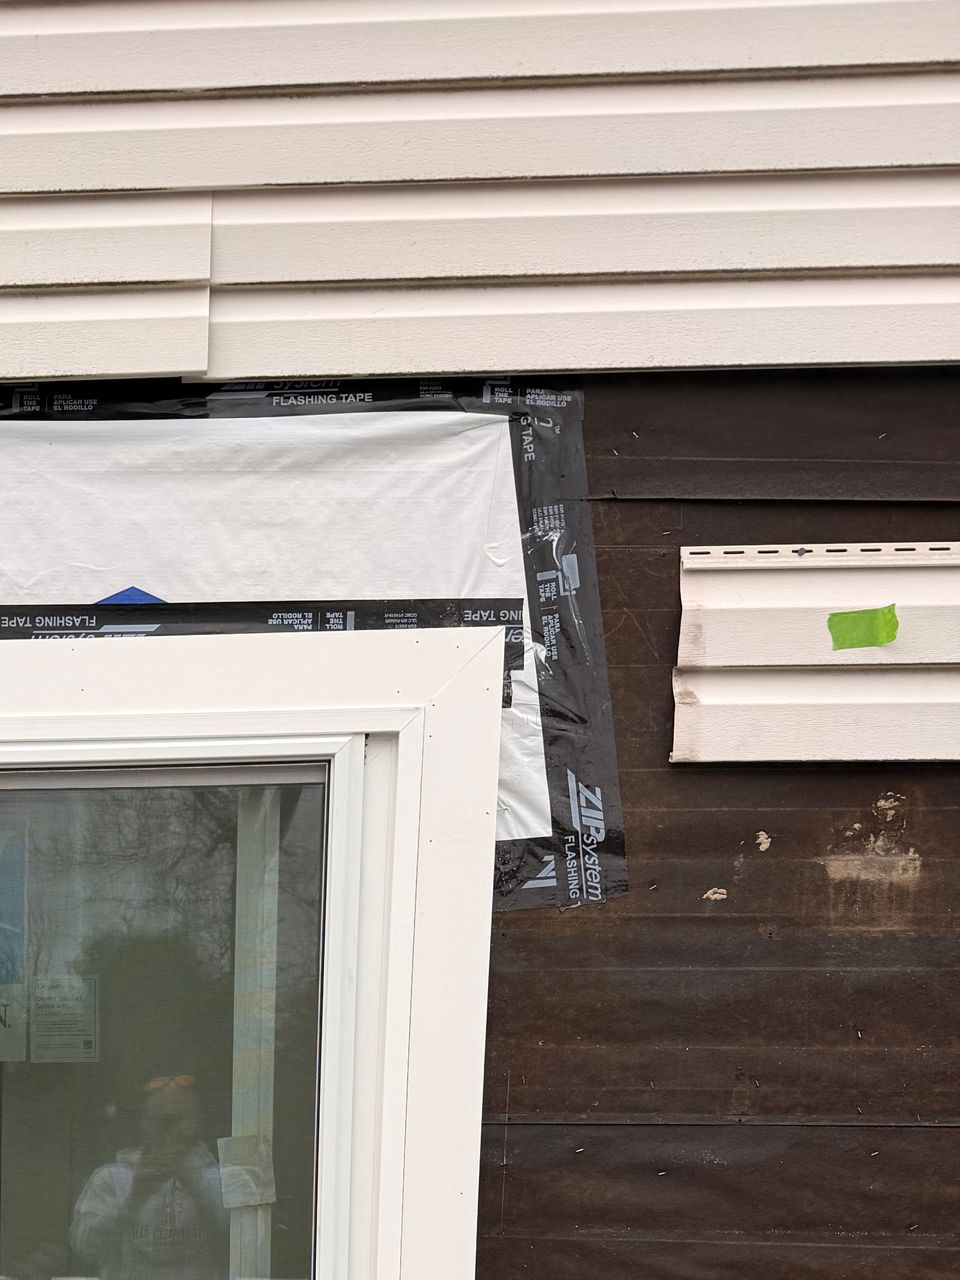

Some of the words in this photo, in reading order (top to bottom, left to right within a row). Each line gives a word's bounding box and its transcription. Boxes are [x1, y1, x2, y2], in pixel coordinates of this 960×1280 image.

[272, 395, 337, 406] FLASHING
[340, 393, 373, 402] TAPE
[522, 427, 535, 462] TAPE
[464, 609, 498, 620] TAPE
[1, 617, 32, 626] TAPE
[35, 616, 96, 627] FLASHING
[542, 616, 547, 625] EL
[564, 835, 580, 899] FLASHING
